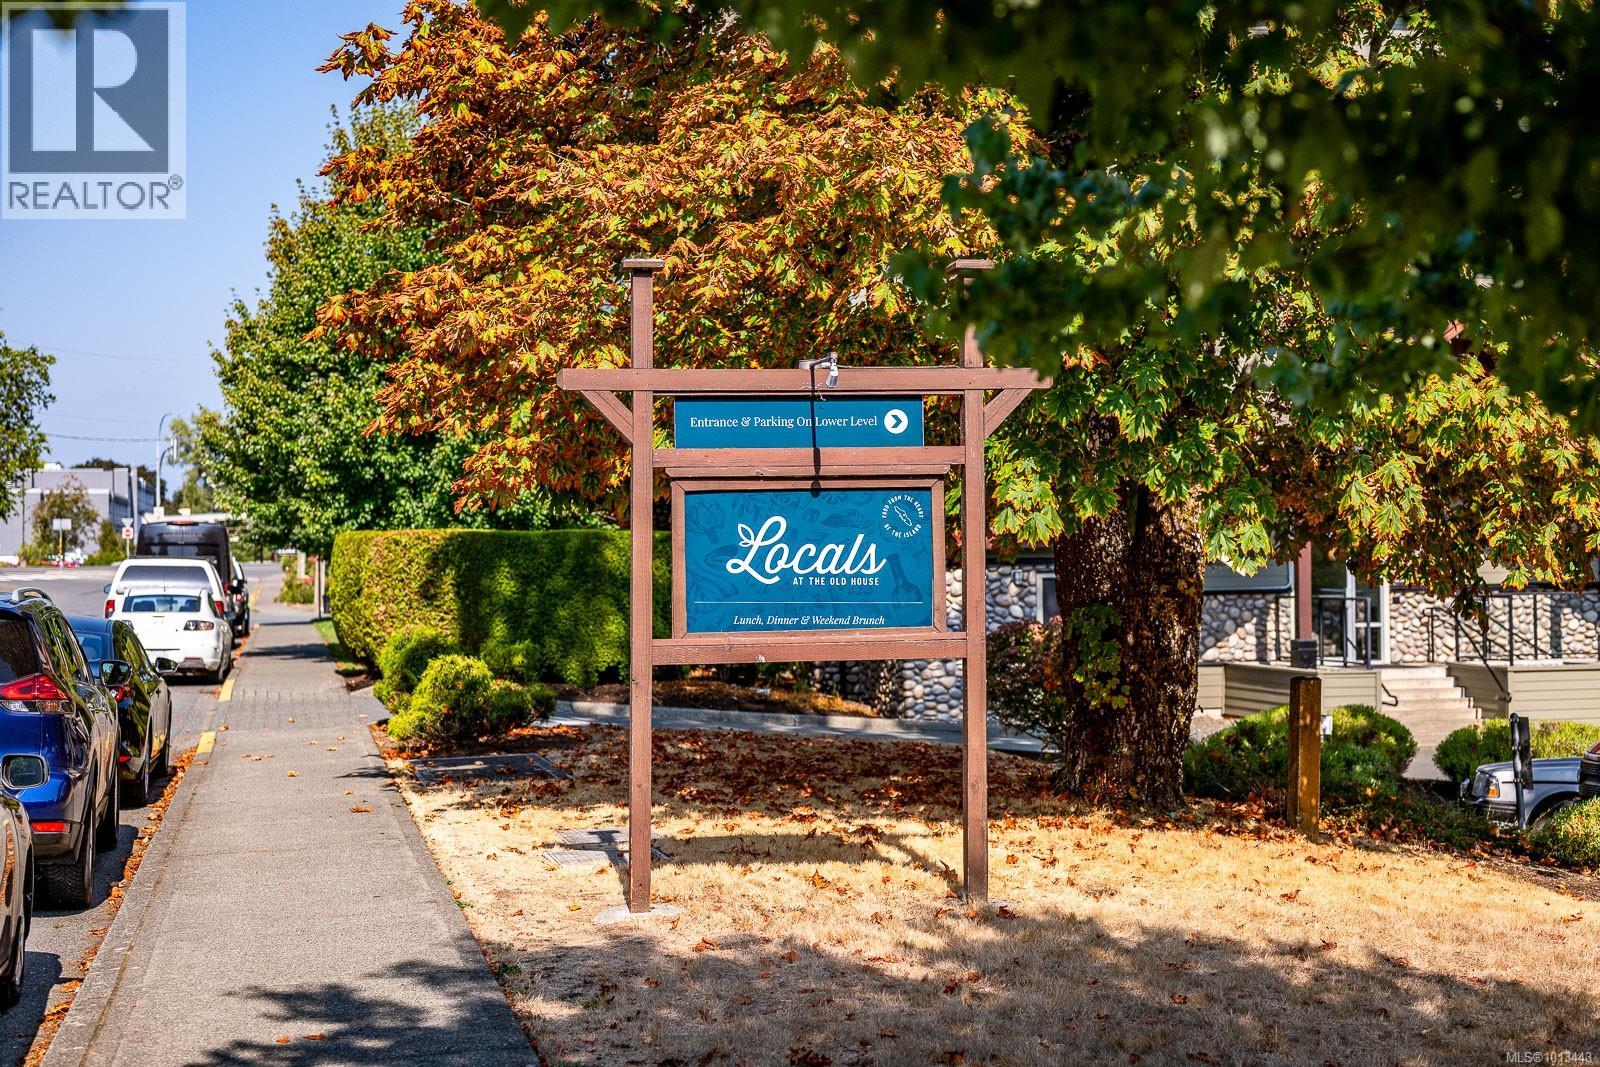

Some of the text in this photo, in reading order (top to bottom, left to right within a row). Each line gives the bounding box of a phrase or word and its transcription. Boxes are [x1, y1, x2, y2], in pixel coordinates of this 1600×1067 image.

[690, 415, 878, 429] Entrance & Parking On Lower Level
[888, 495, 902, 504] FROM
[904, 494, 914, 503] THE
[913, 501, 924, 518] HEART
[891, 529, 902, 538] THE
[903, 523, 922, 538] ISLAND
[725, 515, 887, 585] Locals
[792, 576, 880, 586] AT THE OLD HOUSE
[733, 615, 885, 626] Lunch, Dinner & Weekend Brunch
